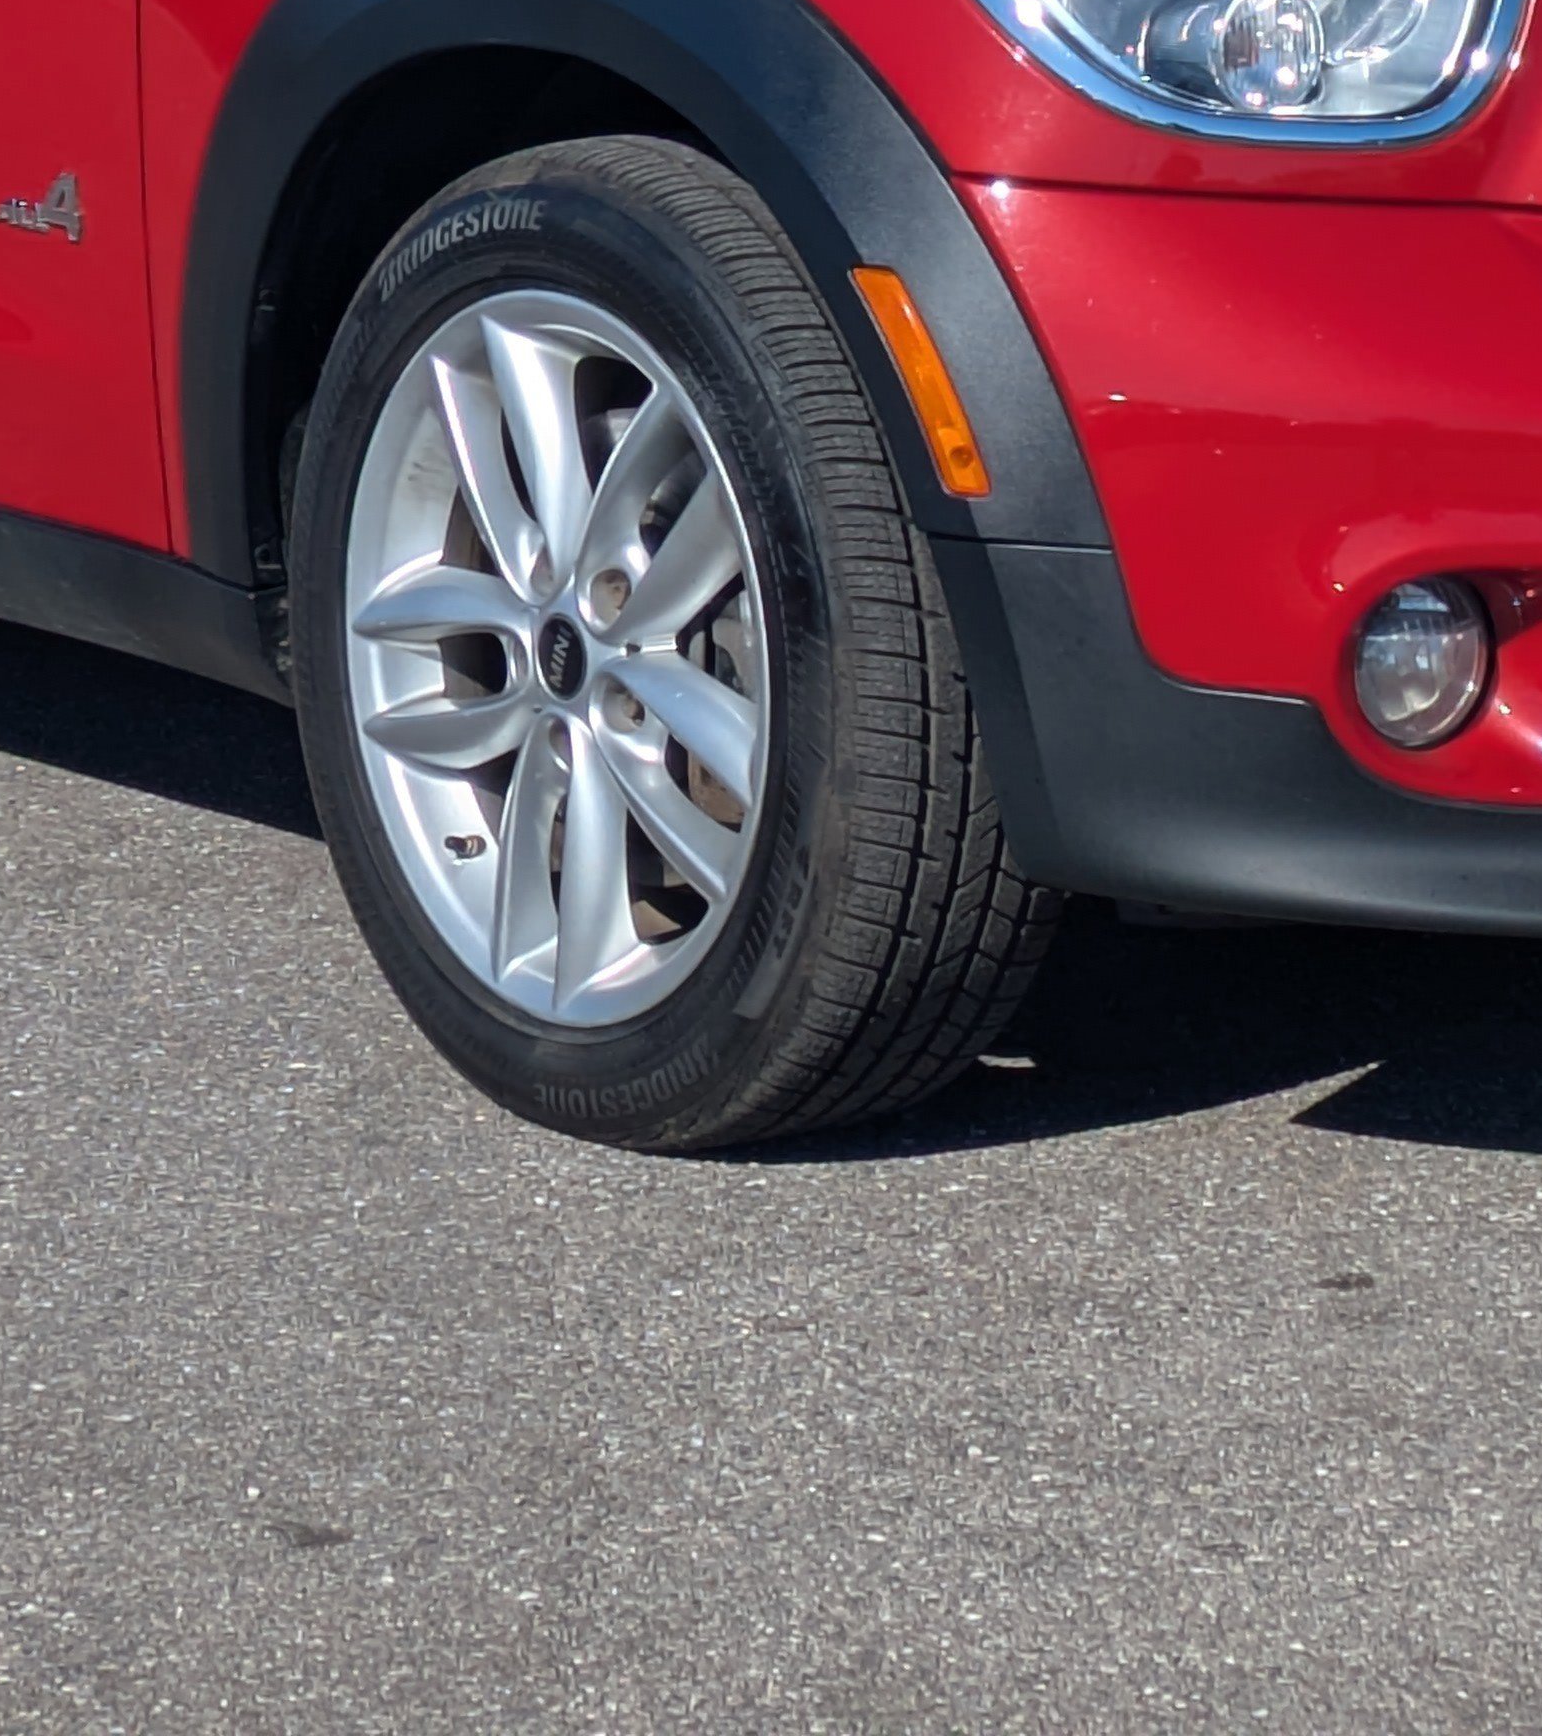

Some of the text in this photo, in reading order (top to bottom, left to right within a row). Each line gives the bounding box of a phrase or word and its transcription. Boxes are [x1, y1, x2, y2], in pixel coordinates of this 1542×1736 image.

[377, 198, 549, 303] BRIDGESTONE
[548, 626, 572, 689] MINI
[533, 1032, 720, 1120] BRIDGESTONE
